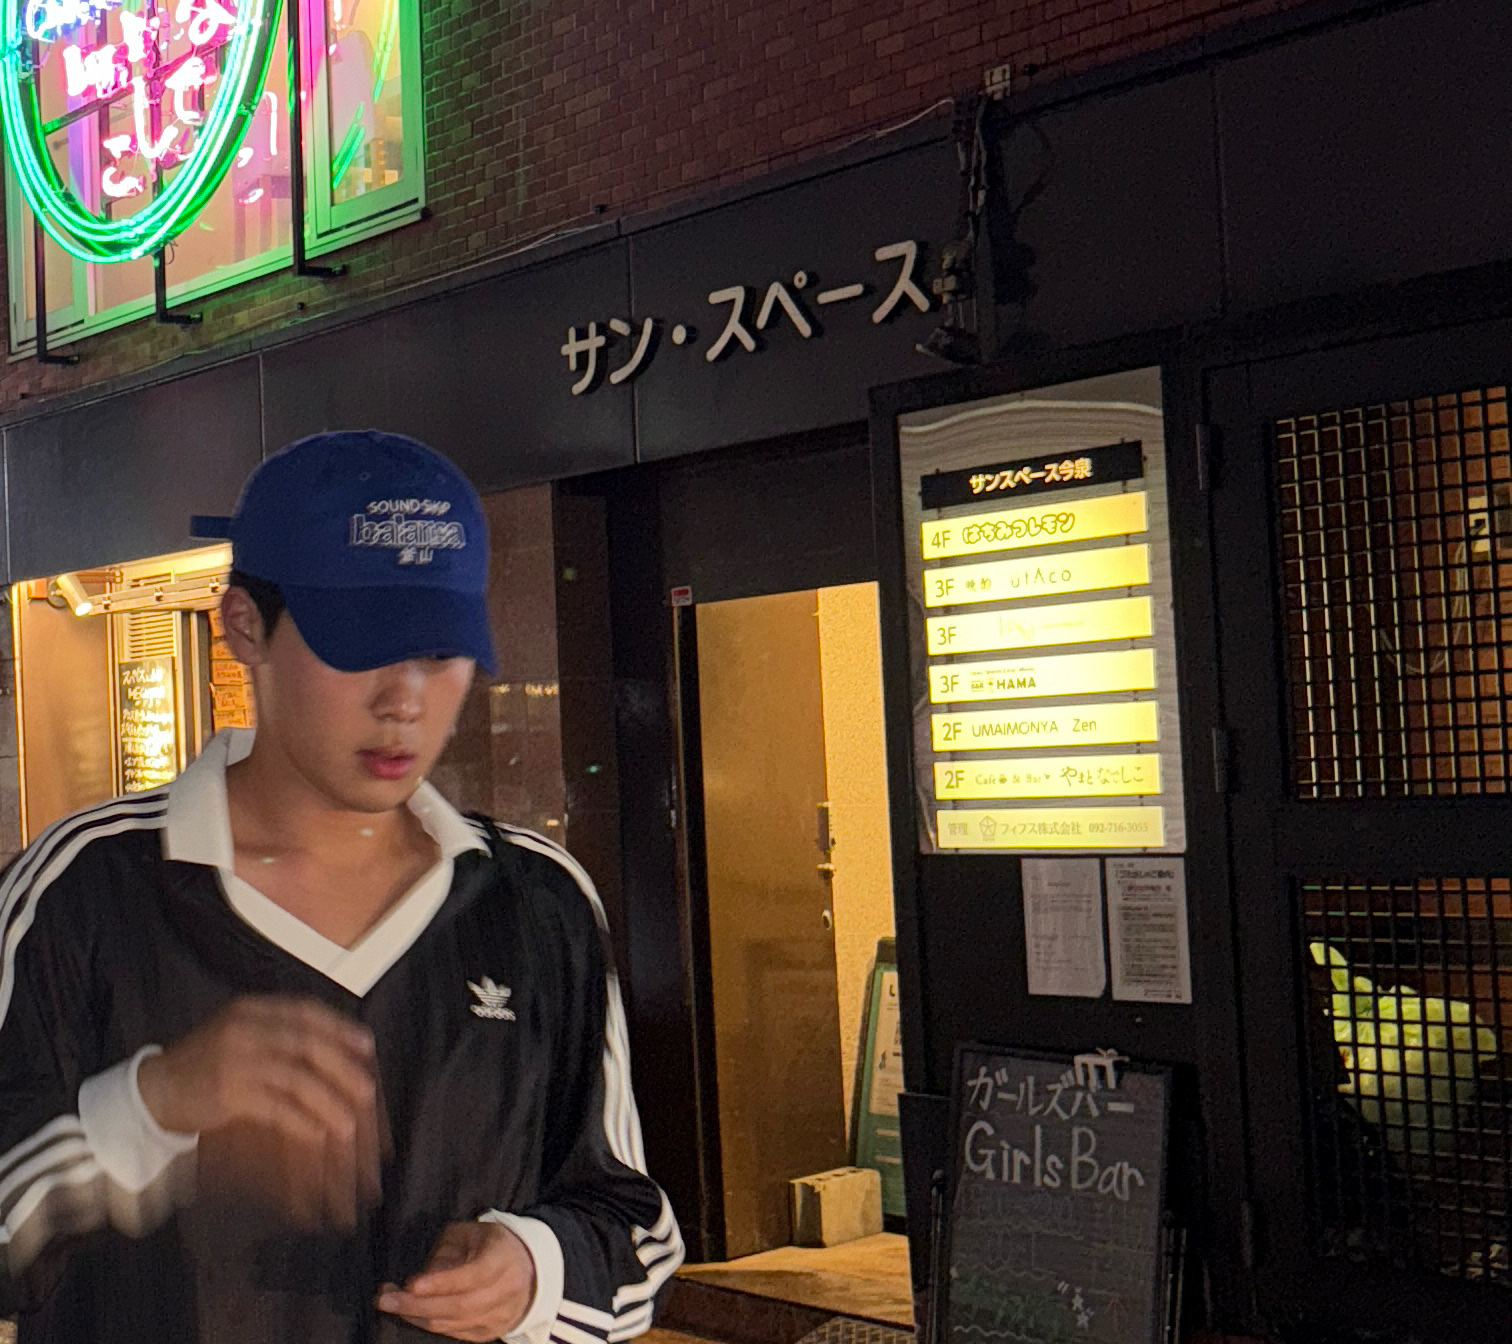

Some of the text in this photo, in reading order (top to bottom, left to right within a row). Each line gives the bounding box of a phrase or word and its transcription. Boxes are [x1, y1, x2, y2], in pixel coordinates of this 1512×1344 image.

[561, 240, 929, 396] サン・スペース
[969, 457, 1093, 494] サンスペース今泉
[367, 499, 419, 514] SOUND
[931, 512, 1075, 548] 4F はちみつレモン
[935, 578, 954, 598] 3F
[937, 626, 956, 646] 3F
[940, 675, 959, 693] 3F
[997, 677, 1036, 690] HAMA
[943, 717, 1097, 741] 2F UMAIMONYA Zen
[945, 770, 964, 789] 2F
[1001, 821, 1082, 836] フィフス株式会社
[965, 1120, 1144, 1201] Girls Bar
